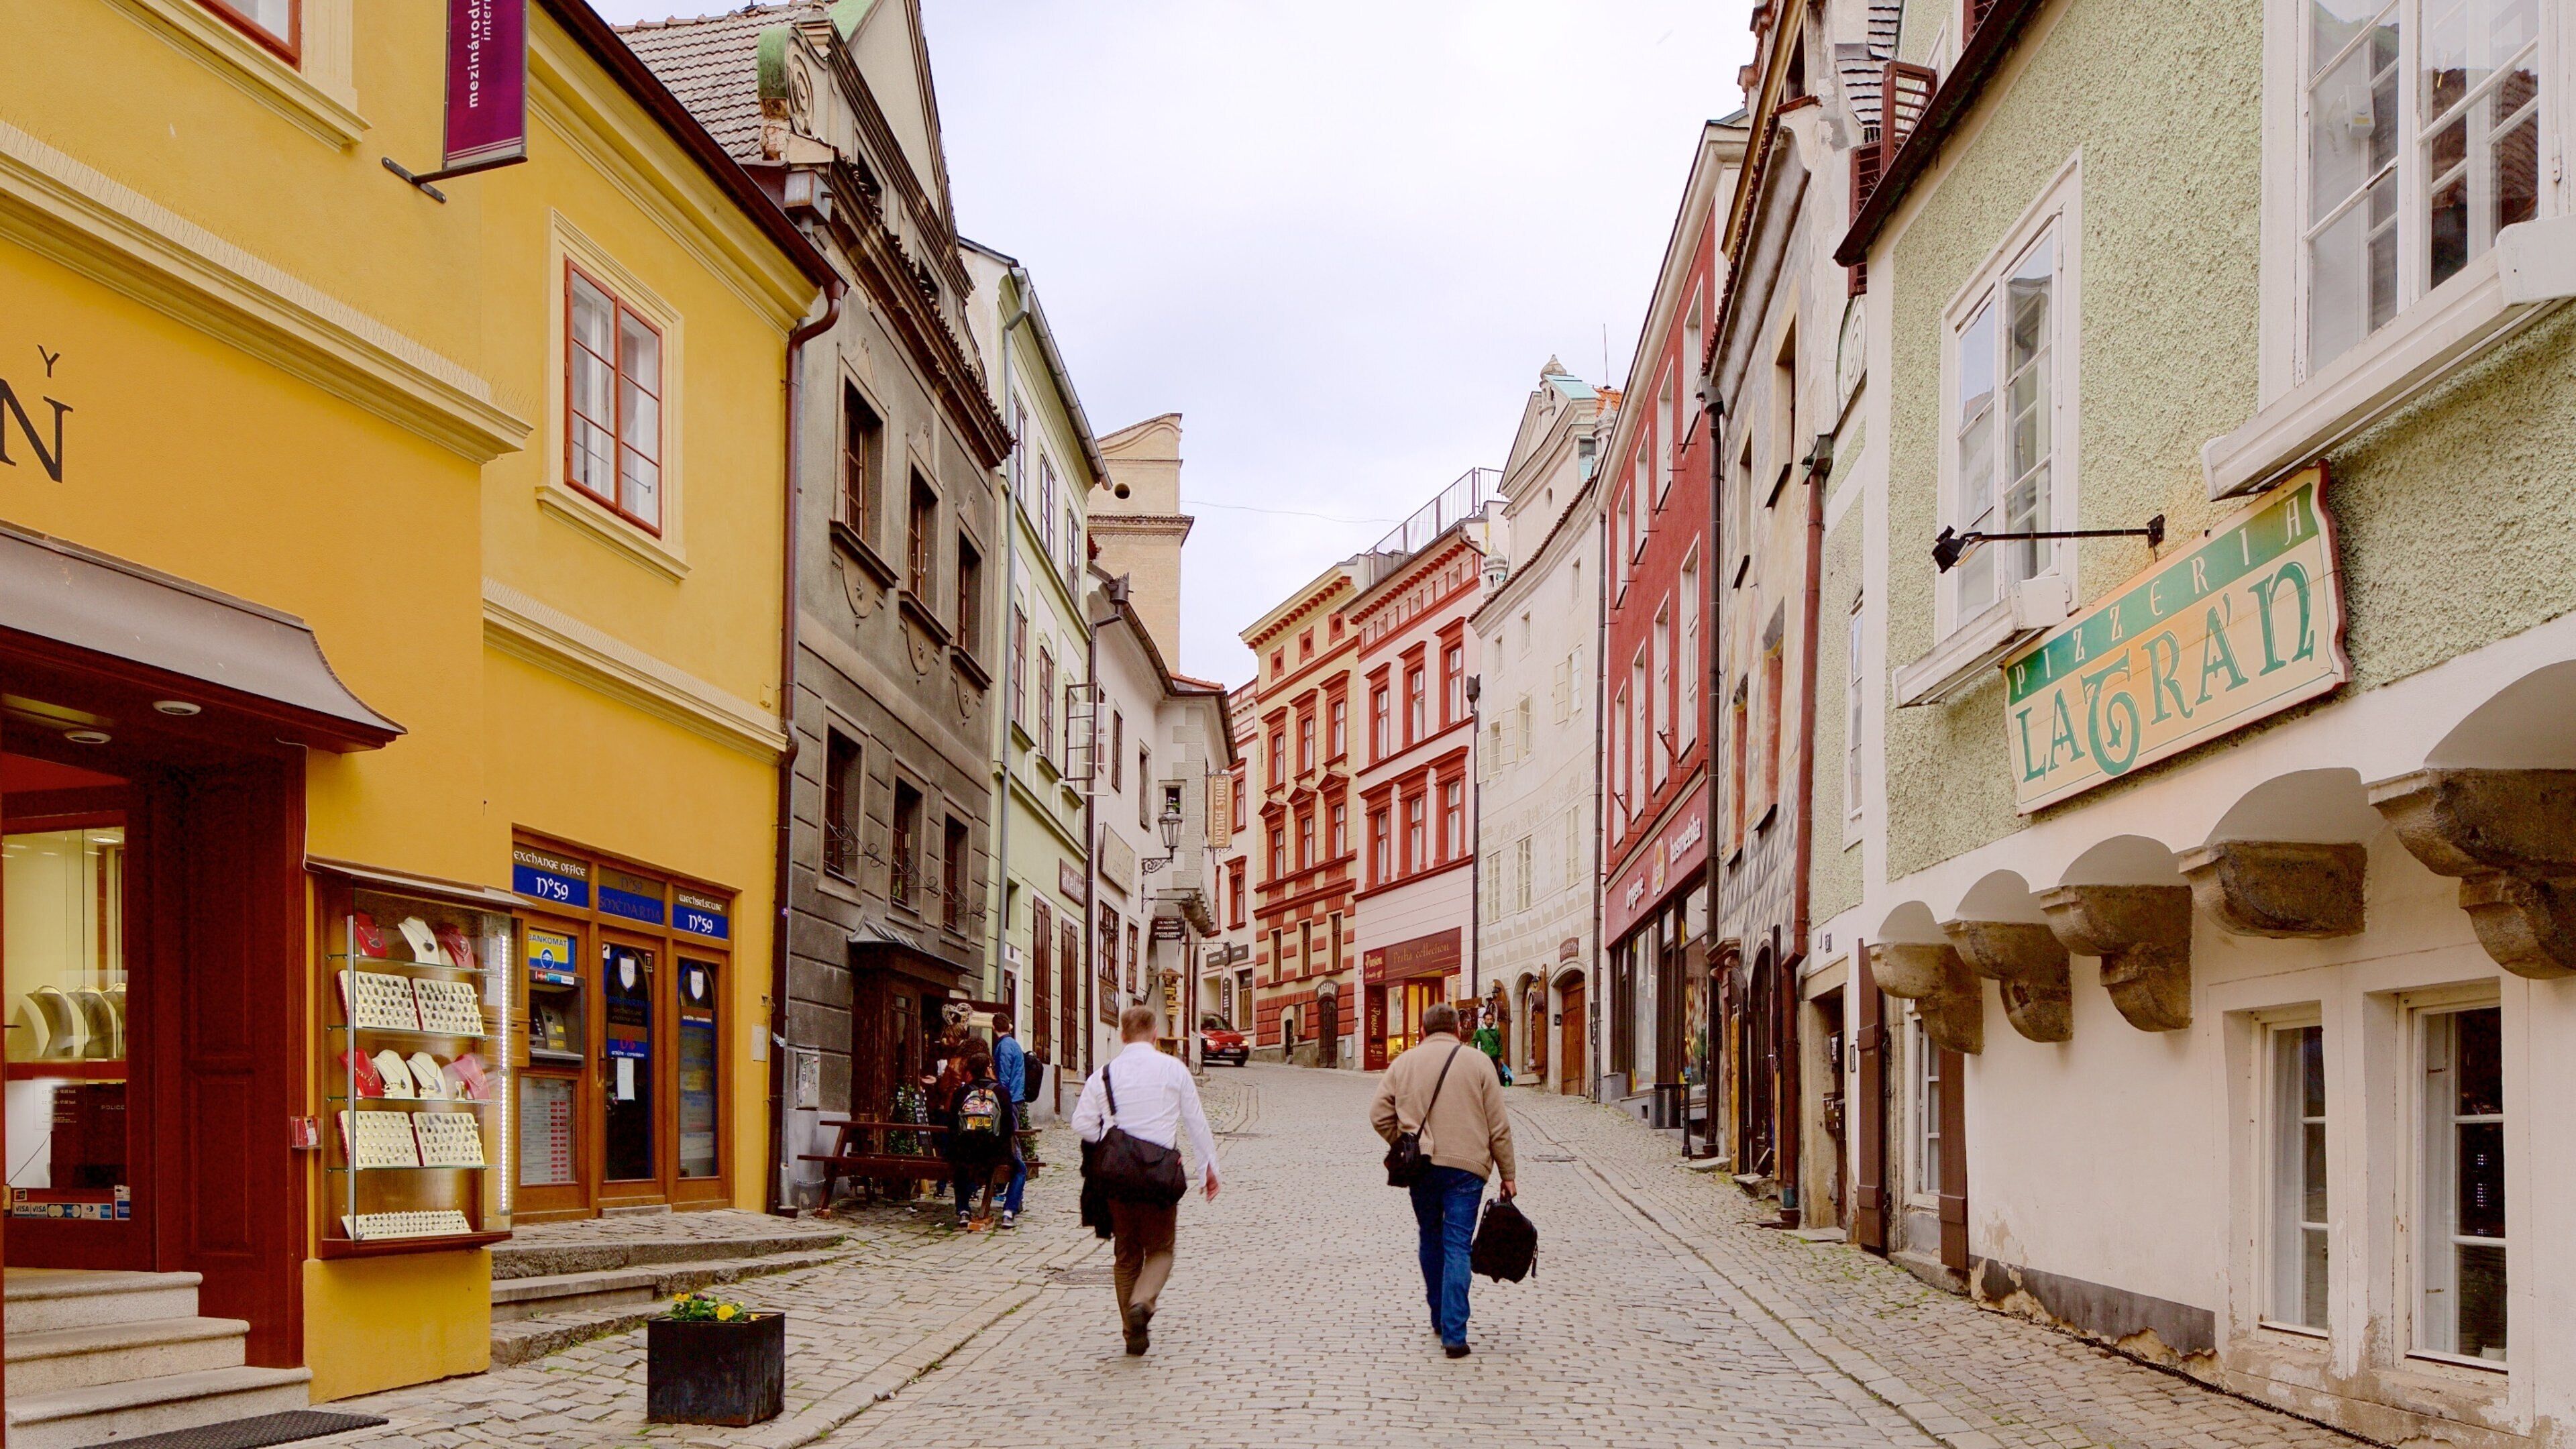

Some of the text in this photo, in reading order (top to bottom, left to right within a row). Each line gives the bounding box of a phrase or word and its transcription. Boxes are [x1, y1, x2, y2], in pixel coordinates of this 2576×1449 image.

[2015, 495, 2303, 696] PIZZERIA
[1215, 777, 1227, 844] VINTAGE STORE
[1670, 812, 1701, 865] kosmetika
[529, 933, 567, 947] BANKOMAT
[1415, 942, 1449, 959] collection
